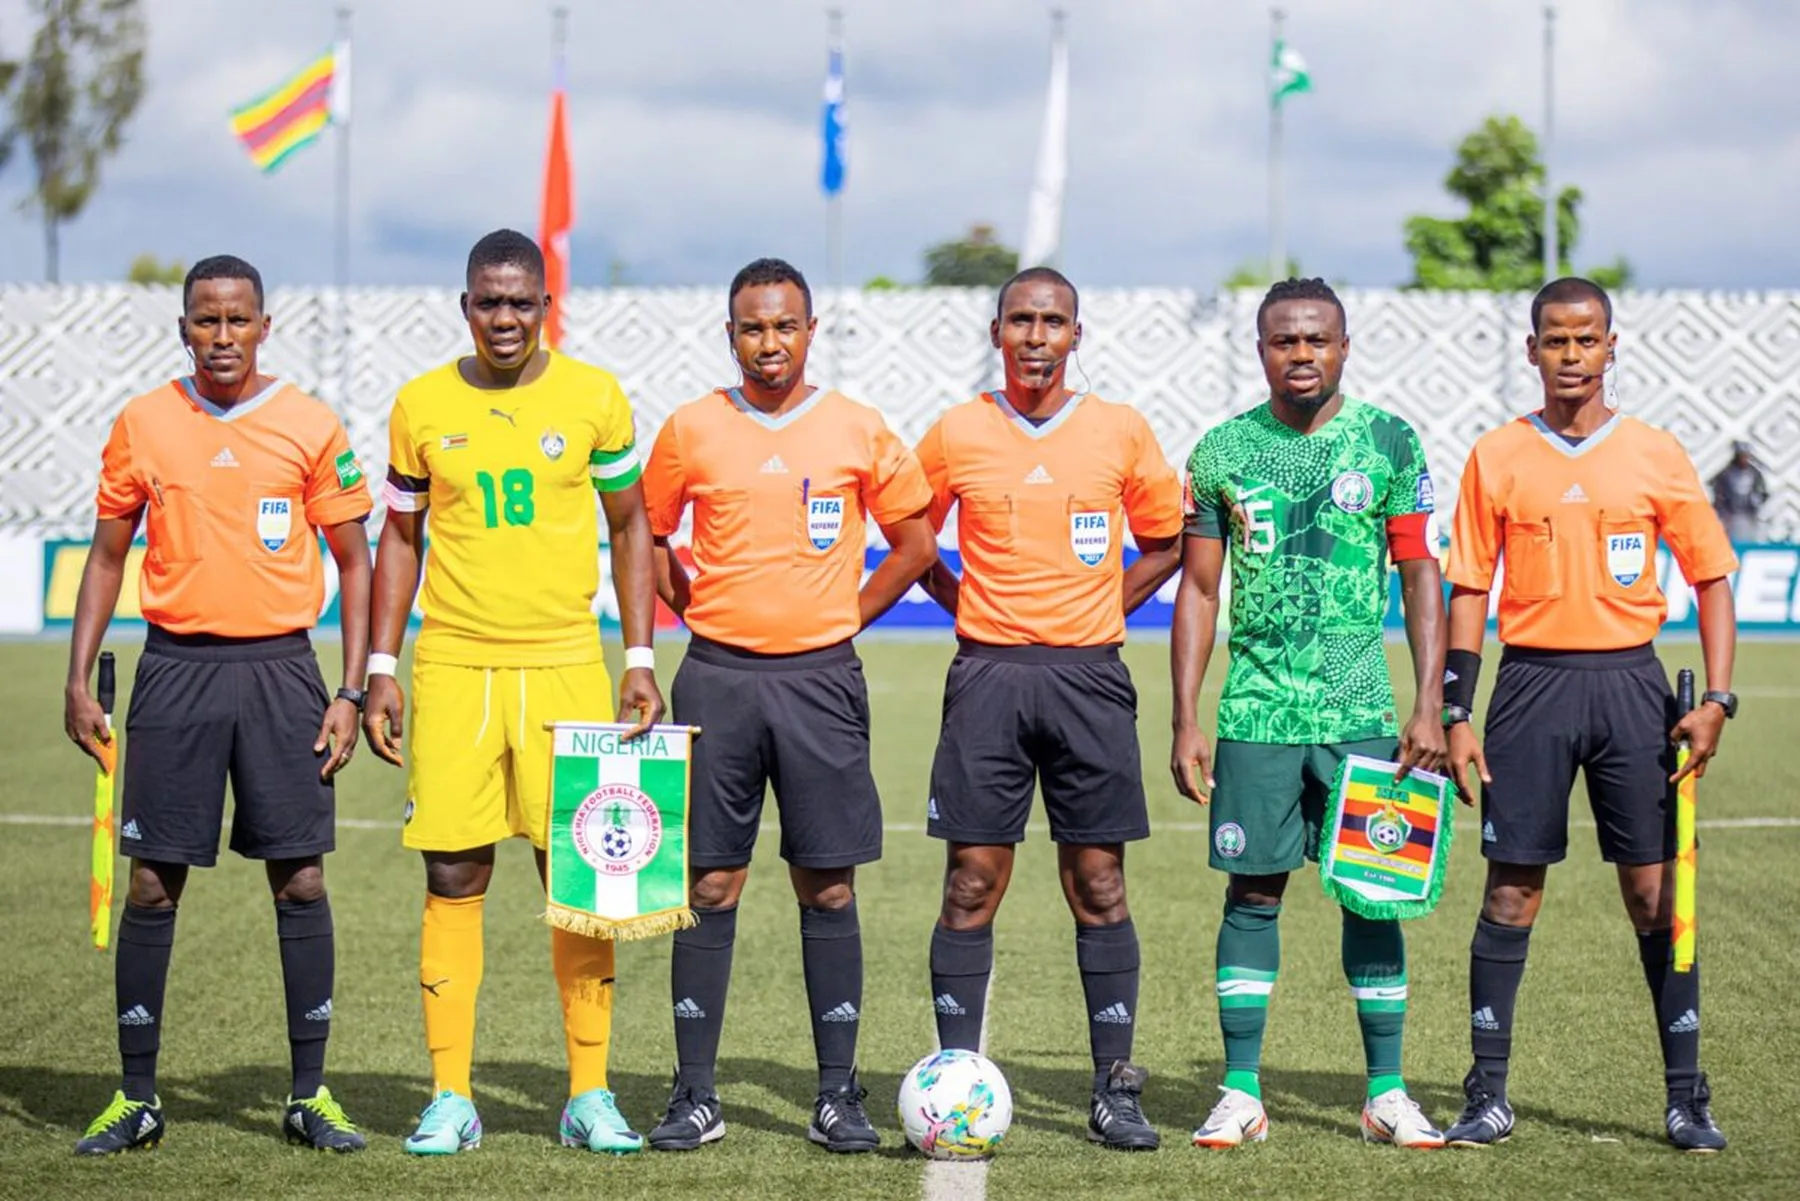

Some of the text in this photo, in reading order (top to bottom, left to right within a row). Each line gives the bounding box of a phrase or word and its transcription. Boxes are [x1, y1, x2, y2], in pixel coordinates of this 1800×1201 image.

[475, 468, 534, 529] 18
[262, 501, 288, 514] FIFA
[811, 501, 841, 514] FIFA
[1074, 515, 1106, 529] FIFA
[1231, 500, 1275, 553] 15
[1611, 537, 1642, 551] FIFA
[572, 731, 669, 756] NIGERIA
[585, 787, 635, 809] FOOTBALL
[636, 795, 660, 857] FEDERATION
[604, 863, 630, 873] 1945
